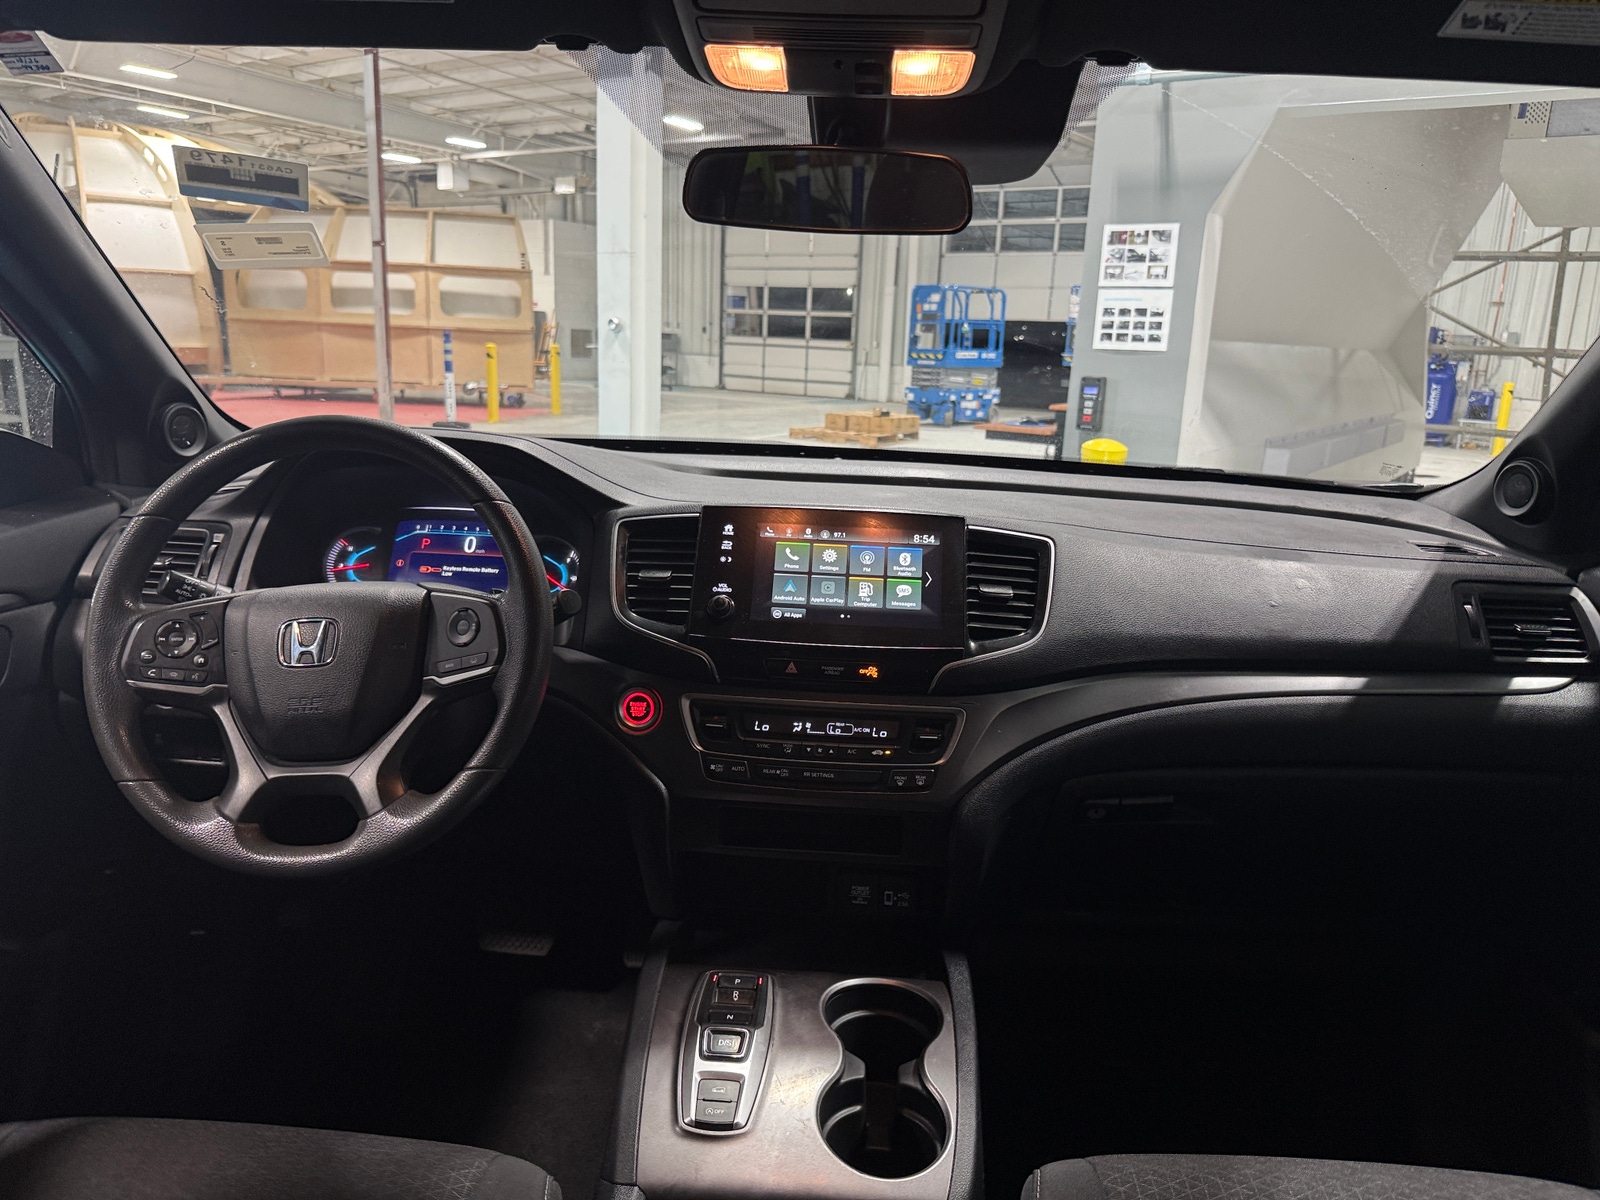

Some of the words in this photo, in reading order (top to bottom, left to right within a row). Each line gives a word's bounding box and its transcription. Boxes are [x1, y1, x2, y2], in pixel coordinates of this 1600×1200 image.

[913, 534, 935, 544] 8:54
[421, 538, 431, 549] P
[463, 536, 477, 553] 0
[175, 589, 190, 597] AUTO
[754, 721, 770, 731] Lo
[872, 727, 887, 737] Lo
[718, 1039, 733, 1047] D/S
